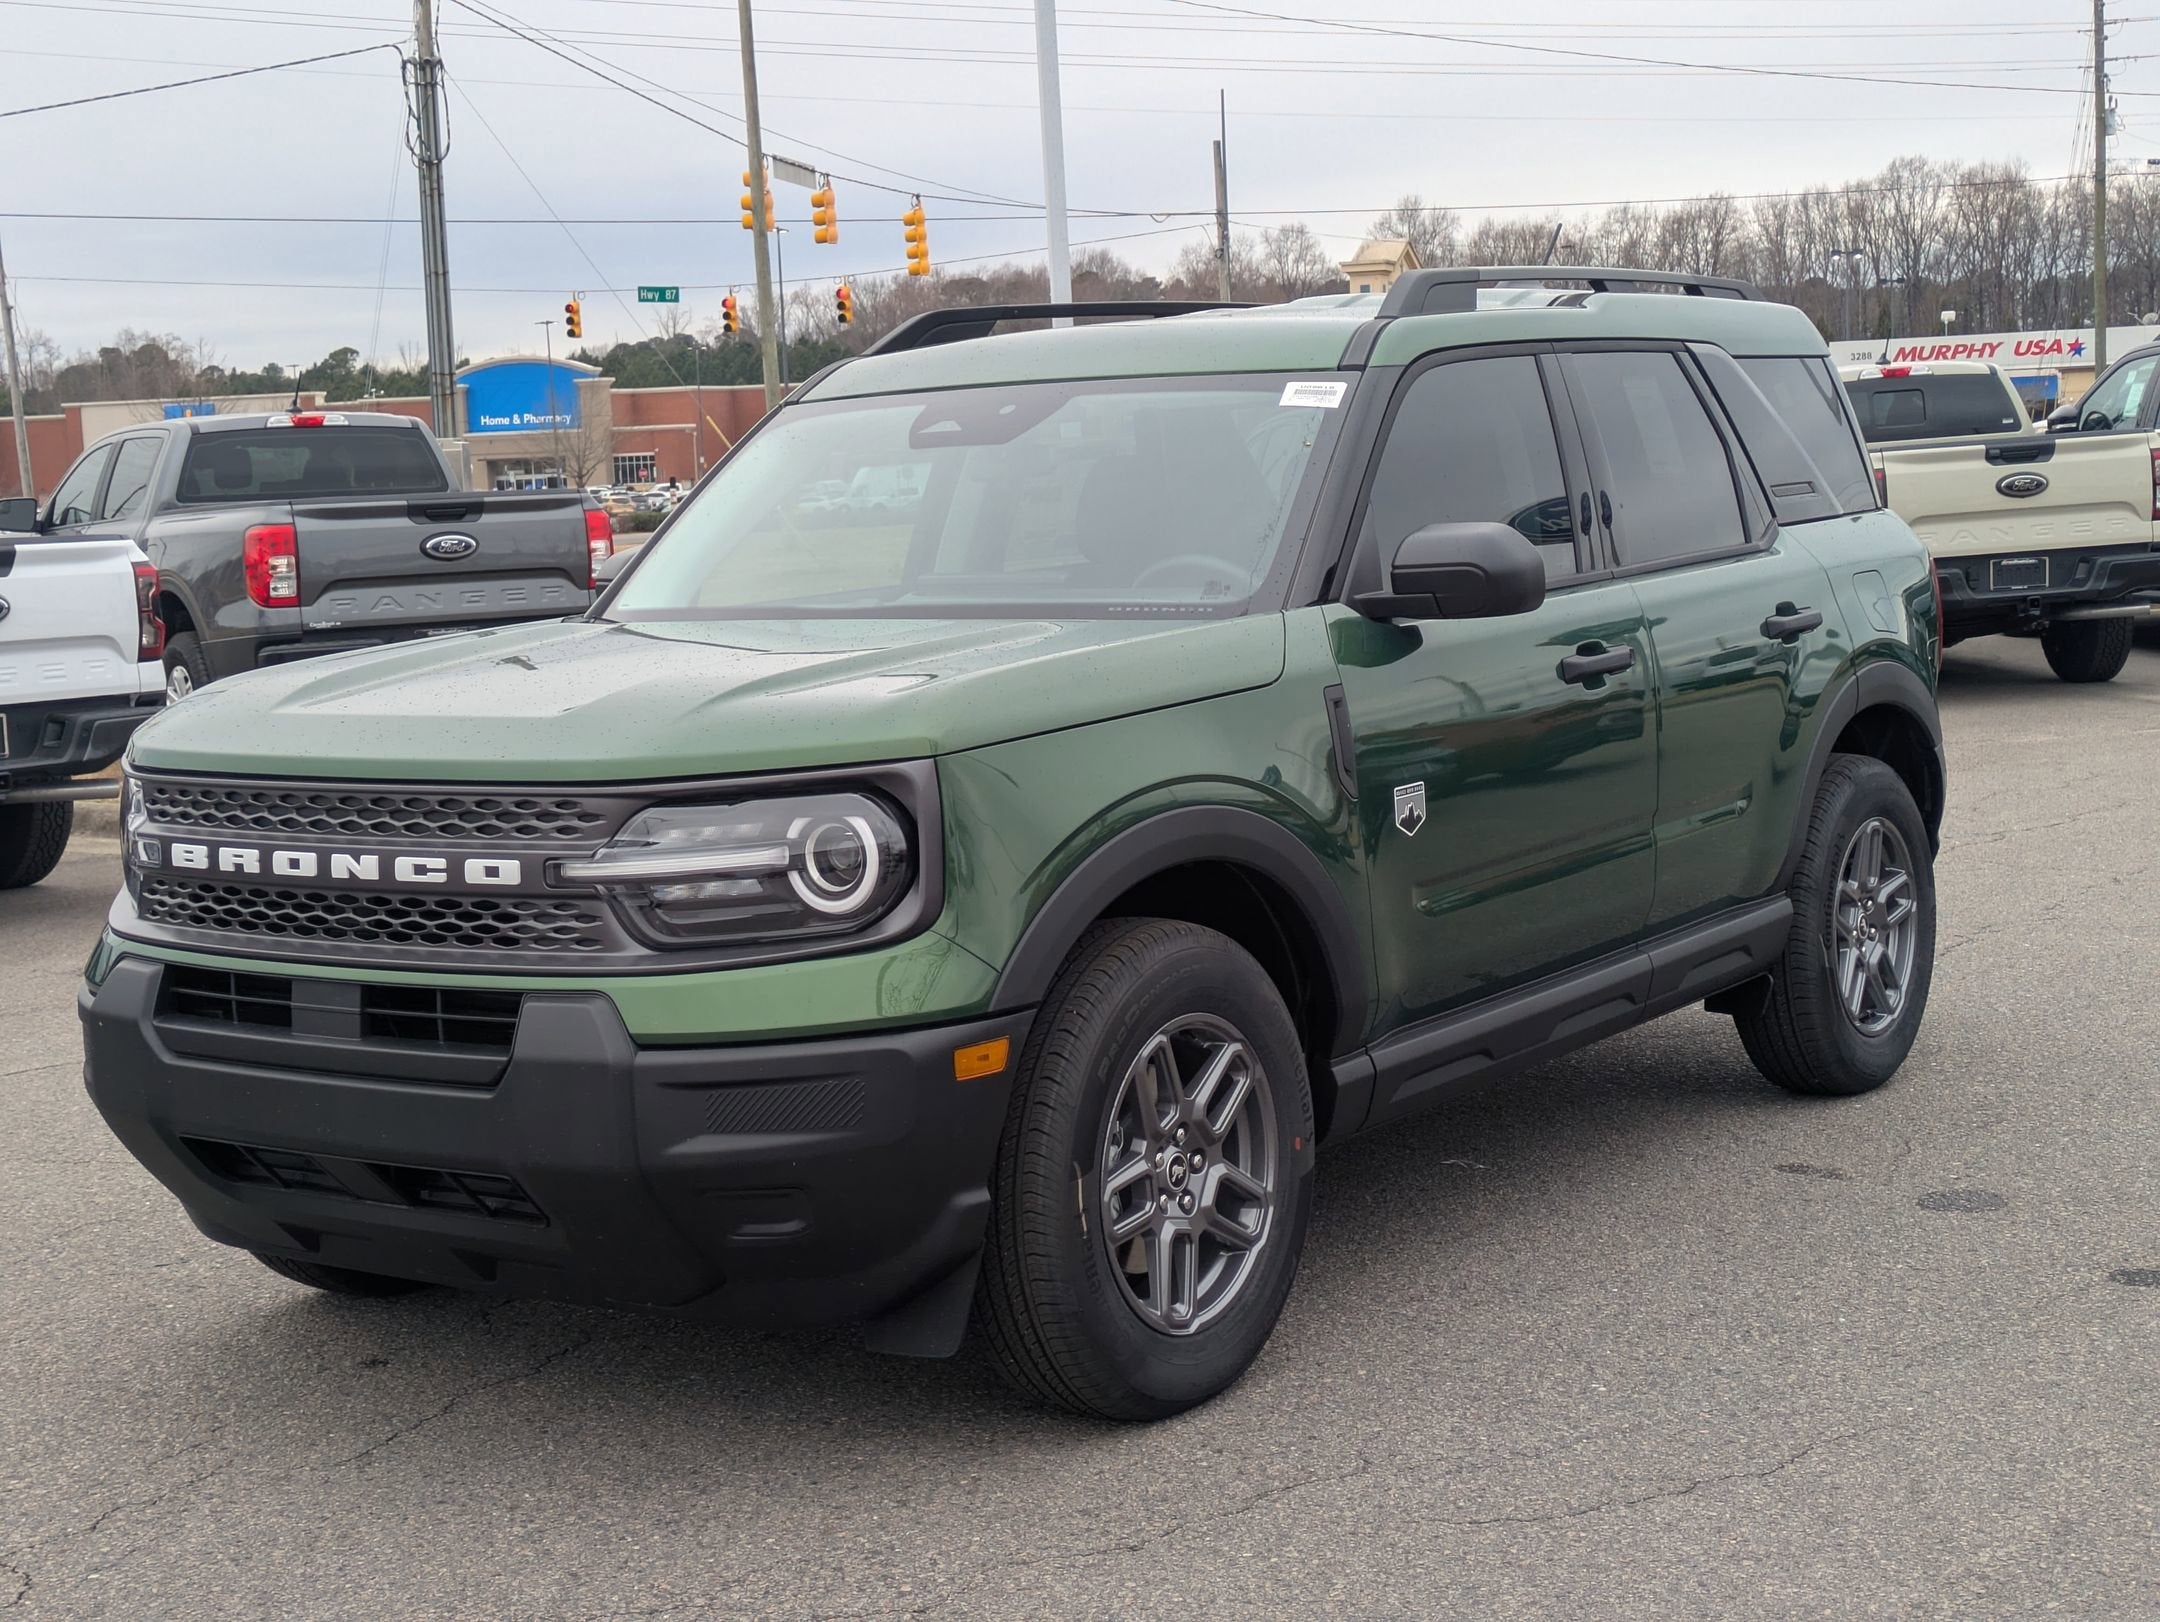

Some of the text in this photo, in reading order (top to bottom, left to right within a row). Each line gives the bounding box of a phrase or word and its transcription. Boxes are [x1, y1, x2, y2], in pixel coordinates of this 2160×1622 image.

[640, 290, 677, 302] Hwy 87
[1850, 352, 1873, 361] 3288
[1893, 339, 2063, 362] MURPHY USA
[481, 413, 572, 426] Home & Pharmacy
[330, 585, 568, 615] RANGER
[171, 842, 522, 885] BRONCO
